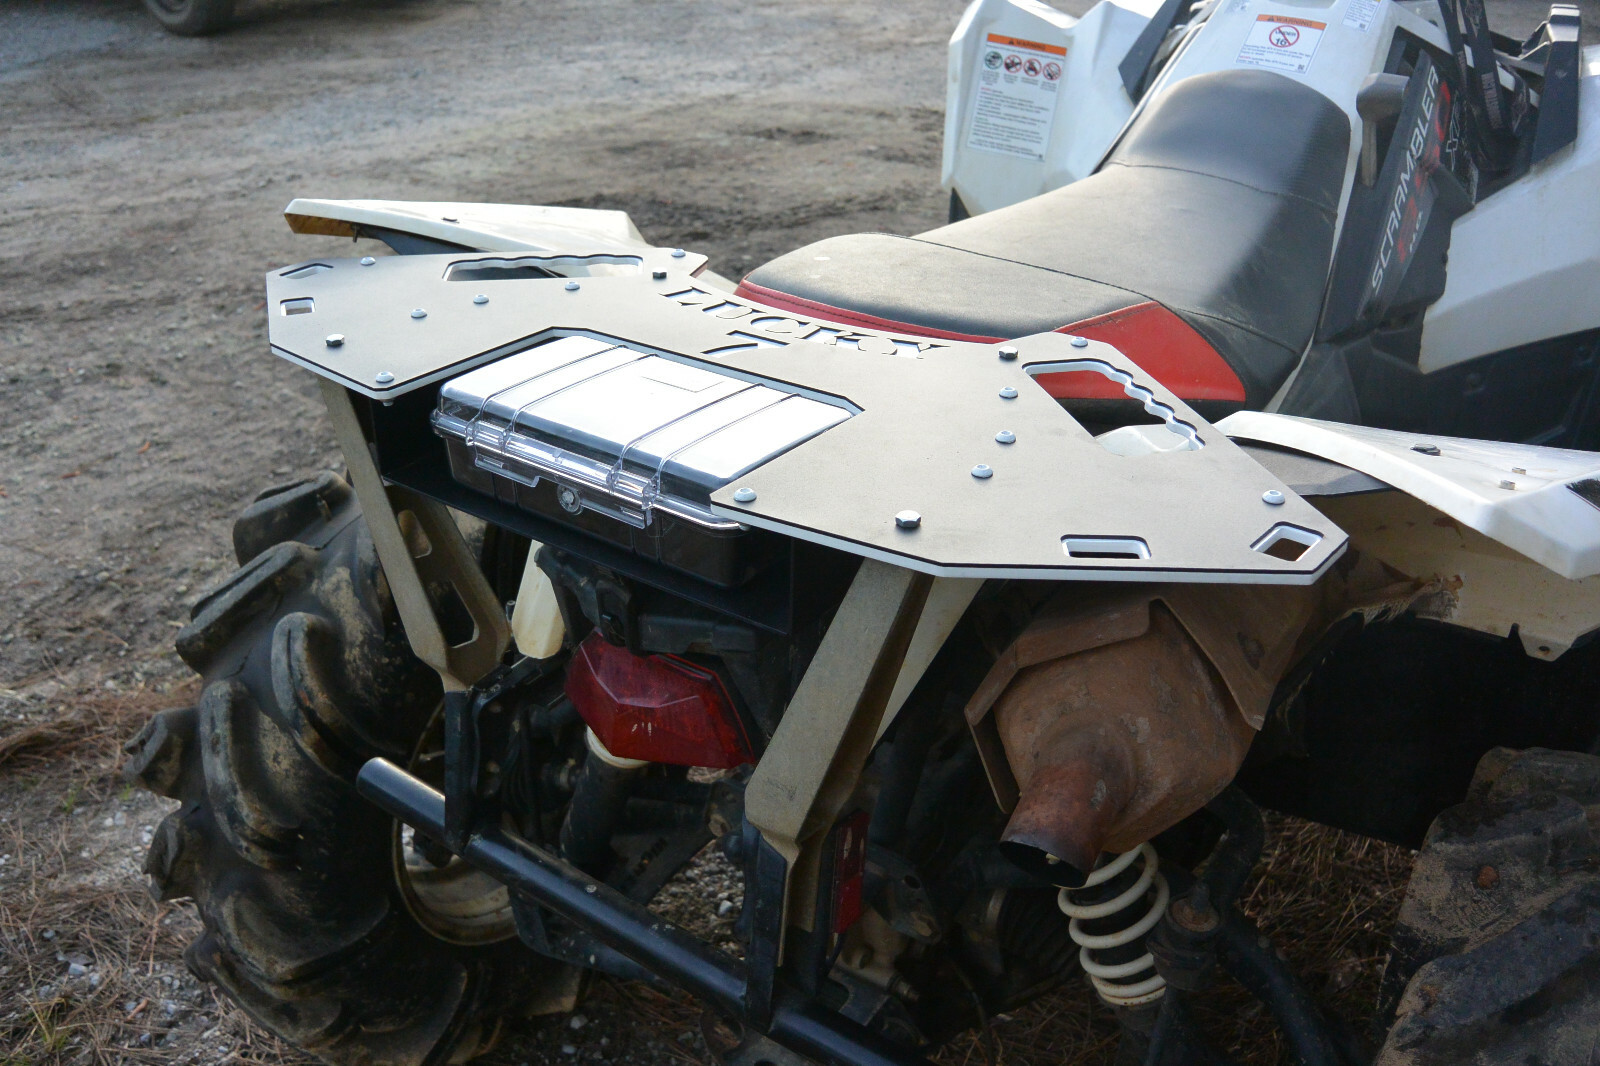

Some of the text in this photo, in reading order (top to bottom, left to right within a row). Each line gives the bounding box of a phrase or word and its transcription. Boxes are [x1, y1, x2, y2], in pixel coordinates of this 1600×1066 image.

[1275, 16, 1313, 28] WARNING
[1016, 39, 1046, 51] WARNING
[1275, 37, 1287, 46] 16
[1371, 64, 1440, 295] SCRAMBLER
[658, 286, 951, 360] LUCKY
[700, 329, 791, 359] 7
